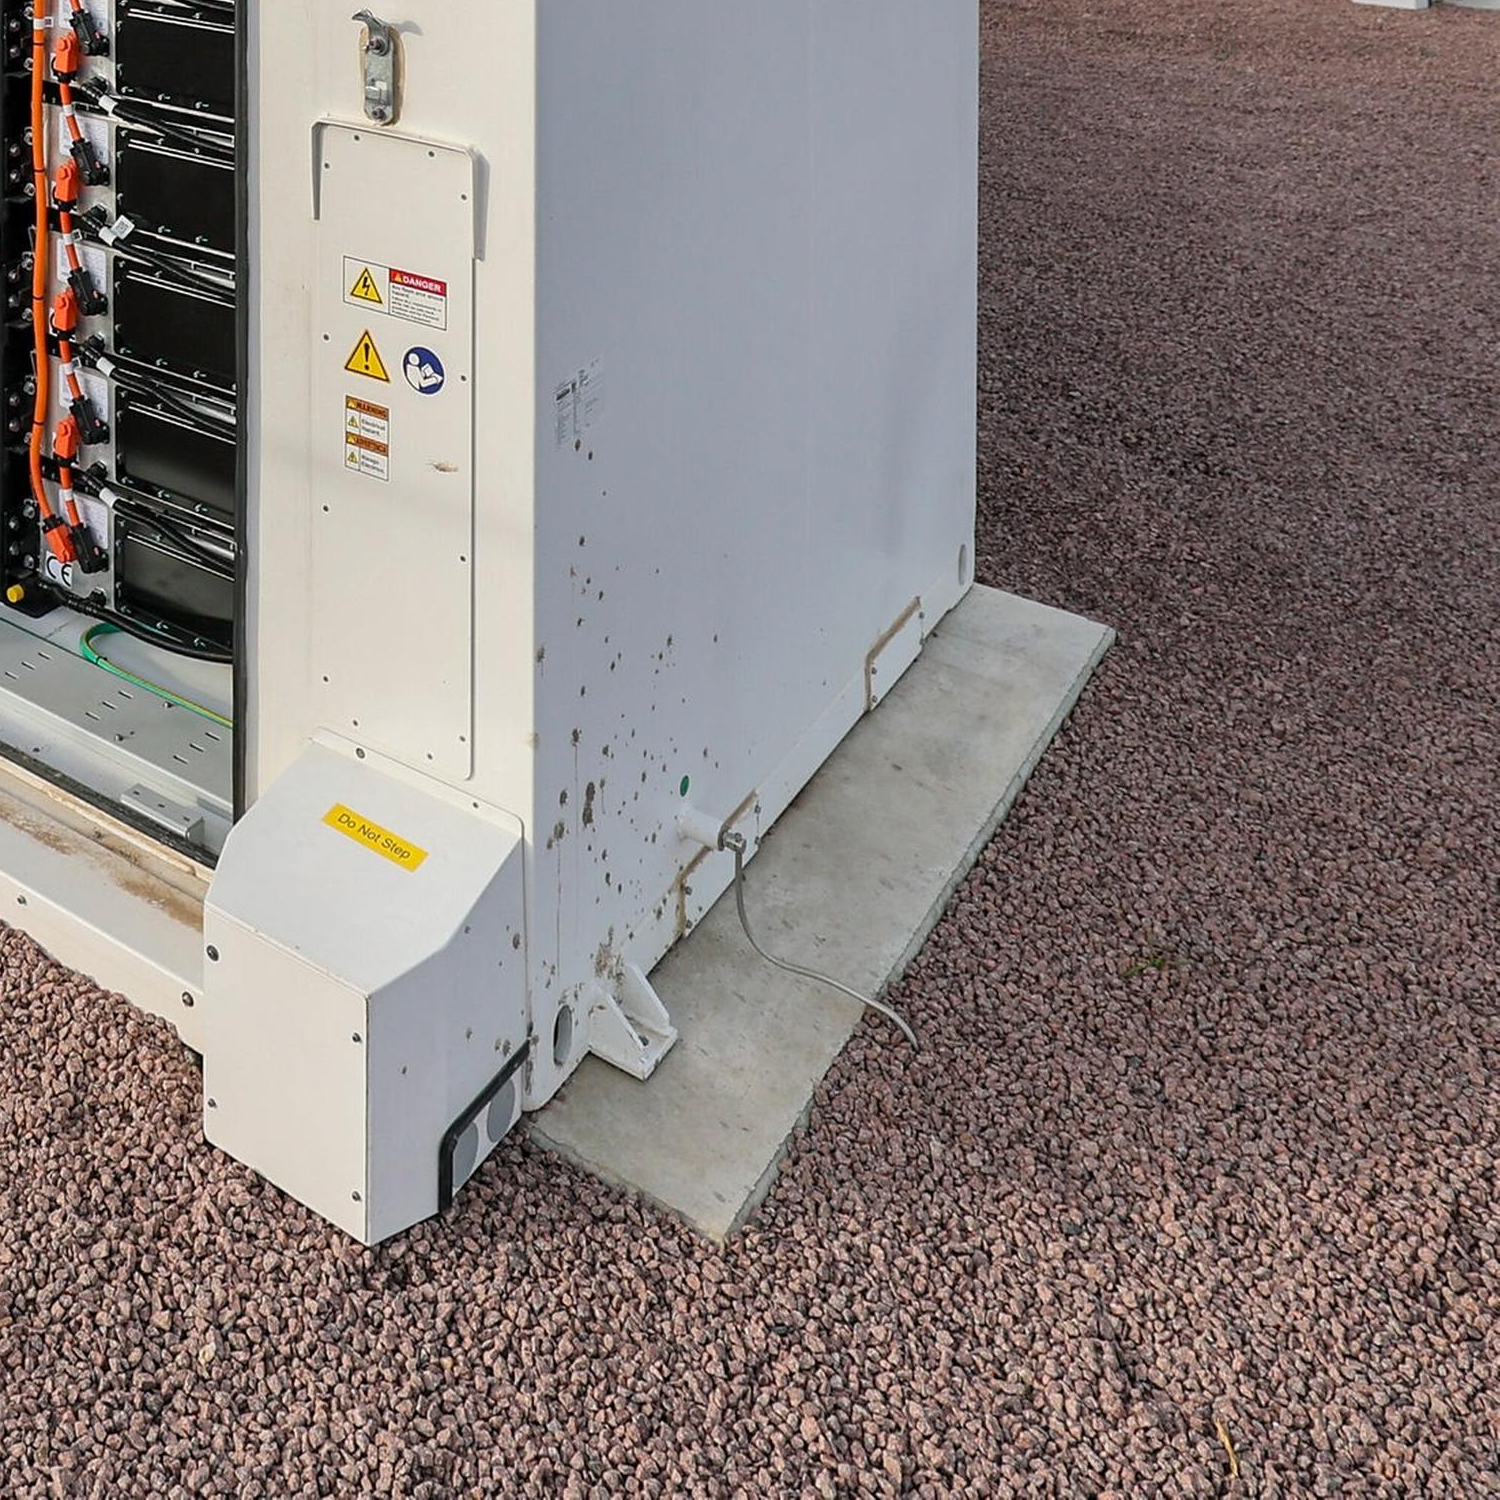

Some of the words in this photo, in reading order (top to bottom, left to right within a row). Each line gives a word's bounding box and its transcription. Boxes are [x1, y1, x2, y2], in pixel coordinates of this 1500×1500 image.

[402, 275, 442, 293] DANGER
[337, 813, 356, 828] Do
[357, 824, 381, 843] Not
[381, 837, 411, 860] Step
